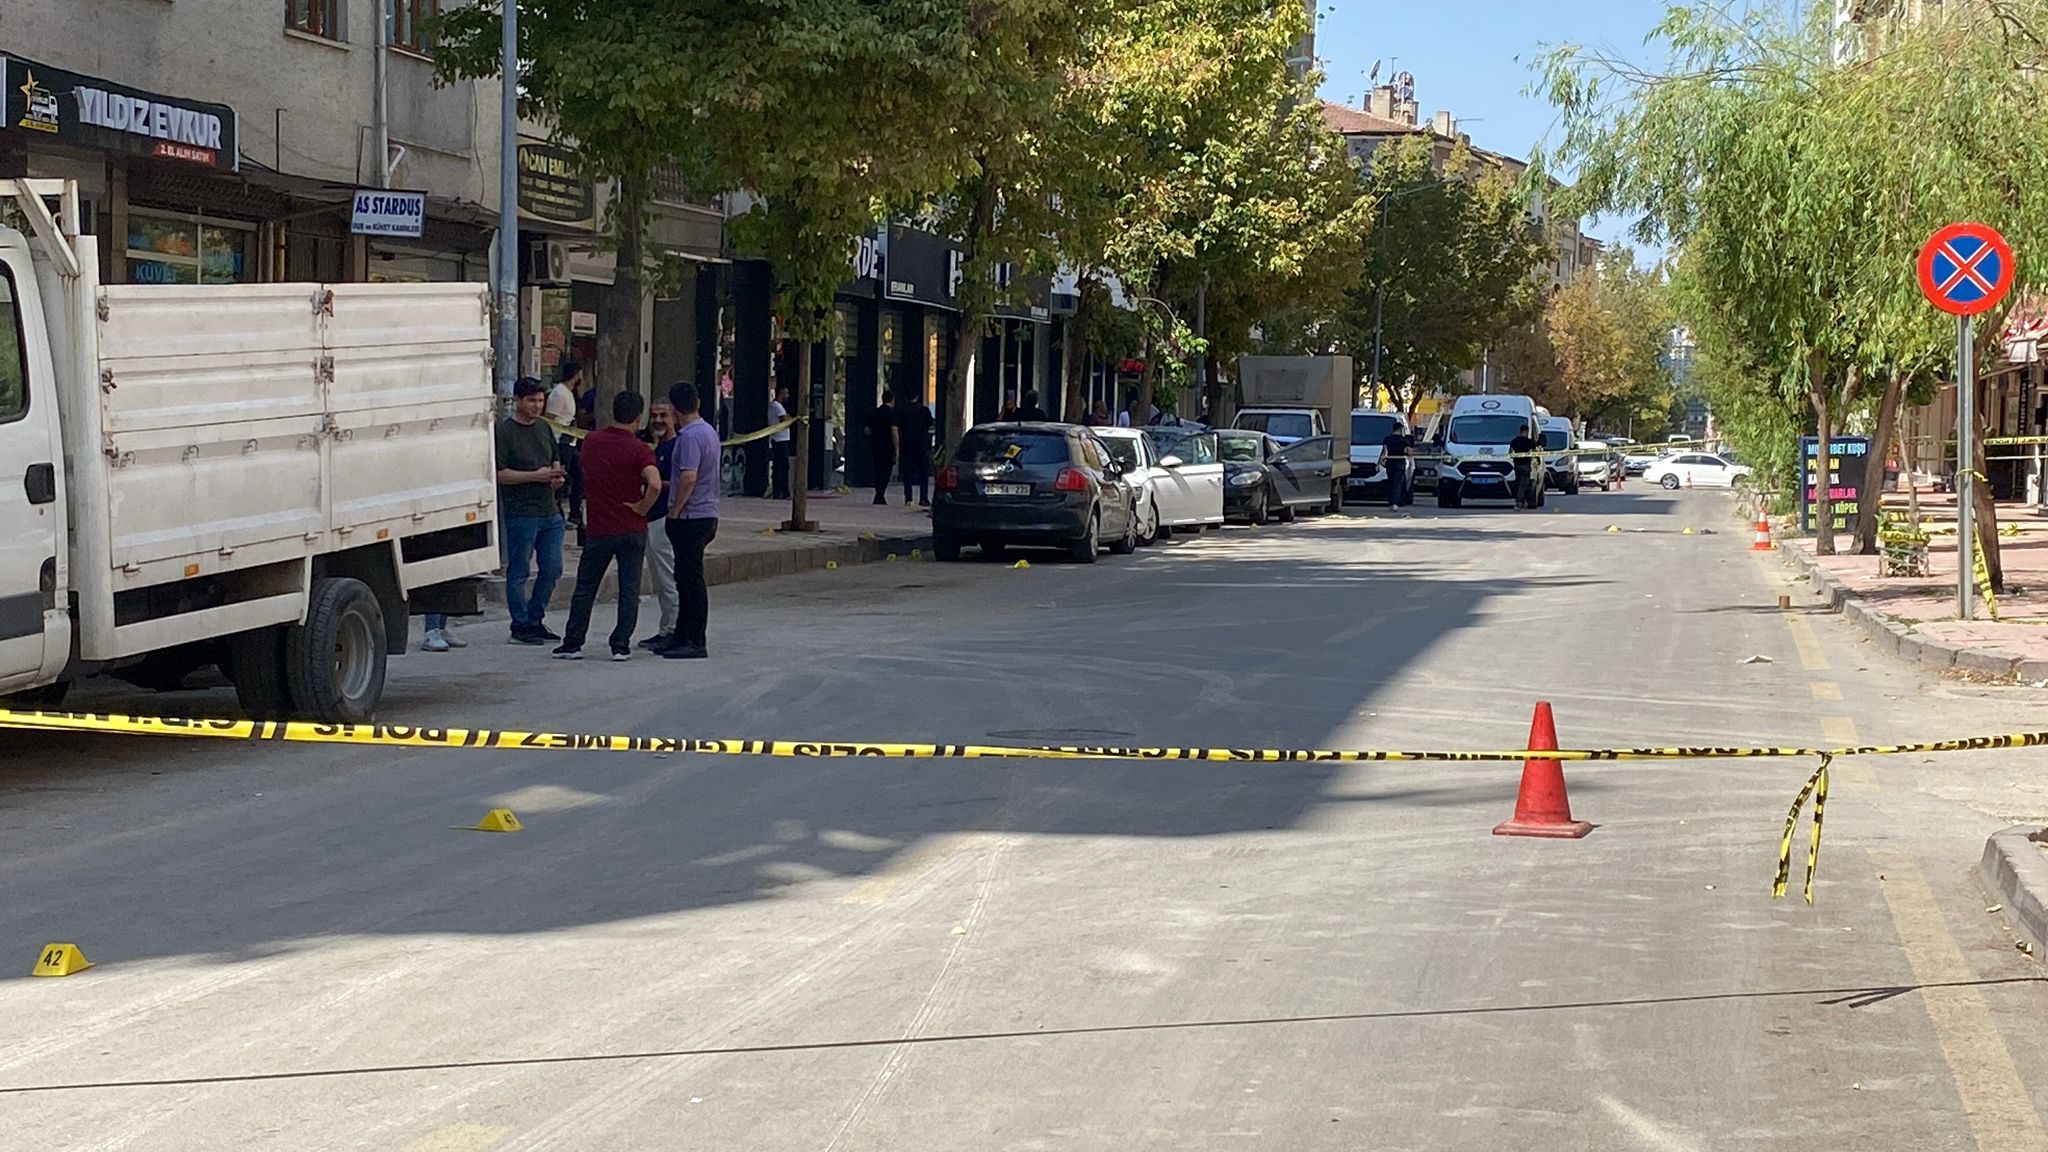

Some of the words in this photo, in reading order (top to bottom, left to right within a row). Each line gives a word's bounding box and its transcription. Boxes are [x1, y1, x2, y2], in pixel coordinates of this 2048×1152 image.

[355, 196, 370, 214] AS
[1808, 443, 1846, 455] MUBET
[1808, 458, 1840, 470] PAAN
[1808, 473, 1840, 485] KAYA
[43, 950, 63, 967] 42
